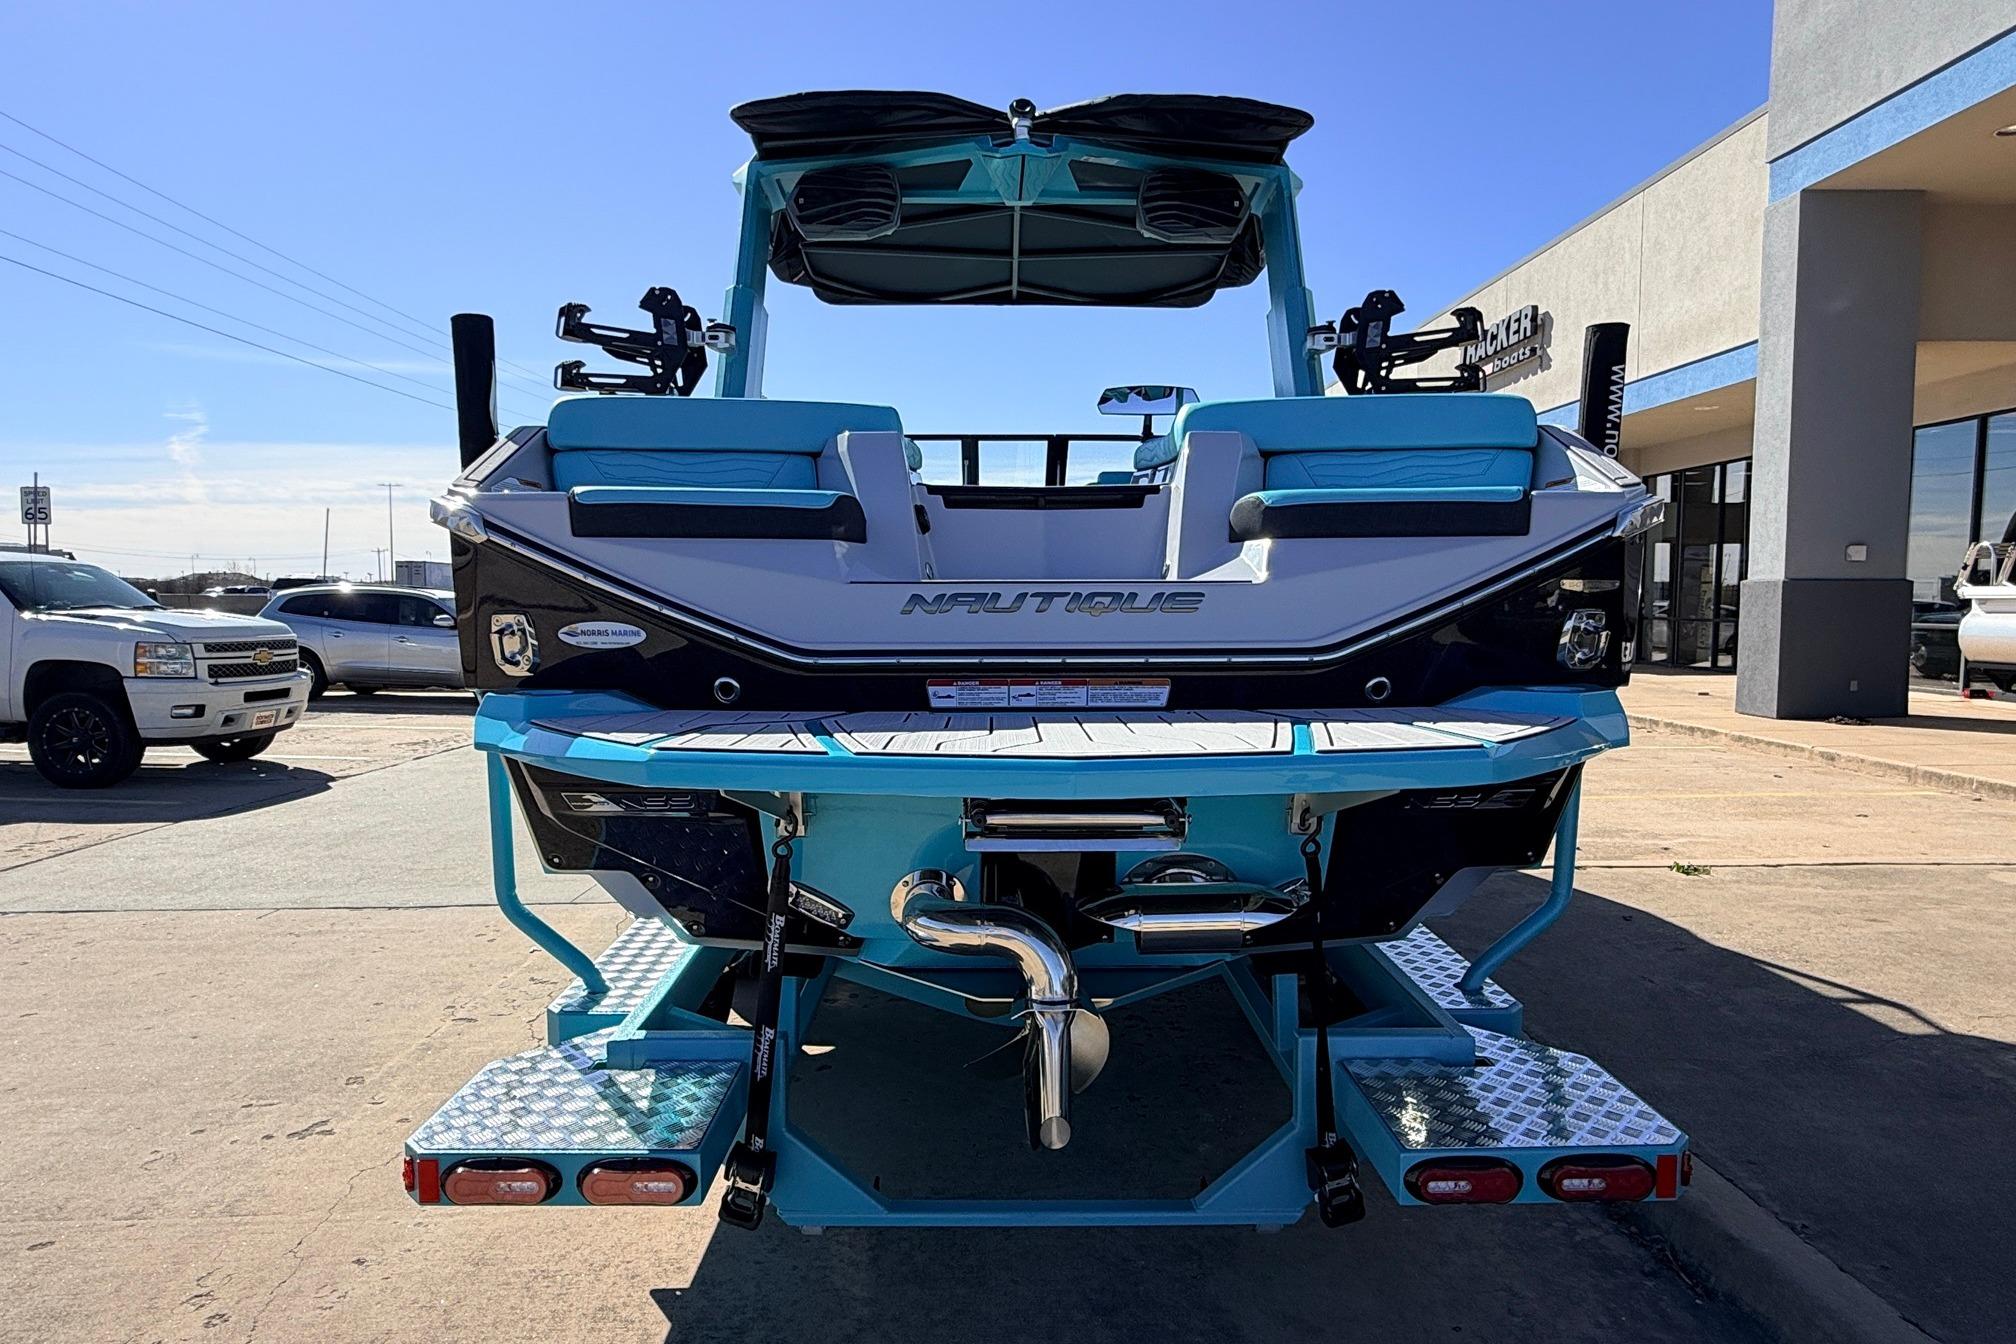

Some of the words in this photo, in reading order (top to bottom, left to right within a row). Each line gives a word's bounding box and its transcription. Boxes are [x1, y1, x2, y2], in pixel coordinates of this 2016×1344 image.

[1493, 345, 1531, 372] boats
[24, 507, 48, 520] 65
[900, 591, 1206, 617] NAUTIQUE
[580, 629, 609, 637] NORRIS
[611, 629, 642, 637] MARINE
